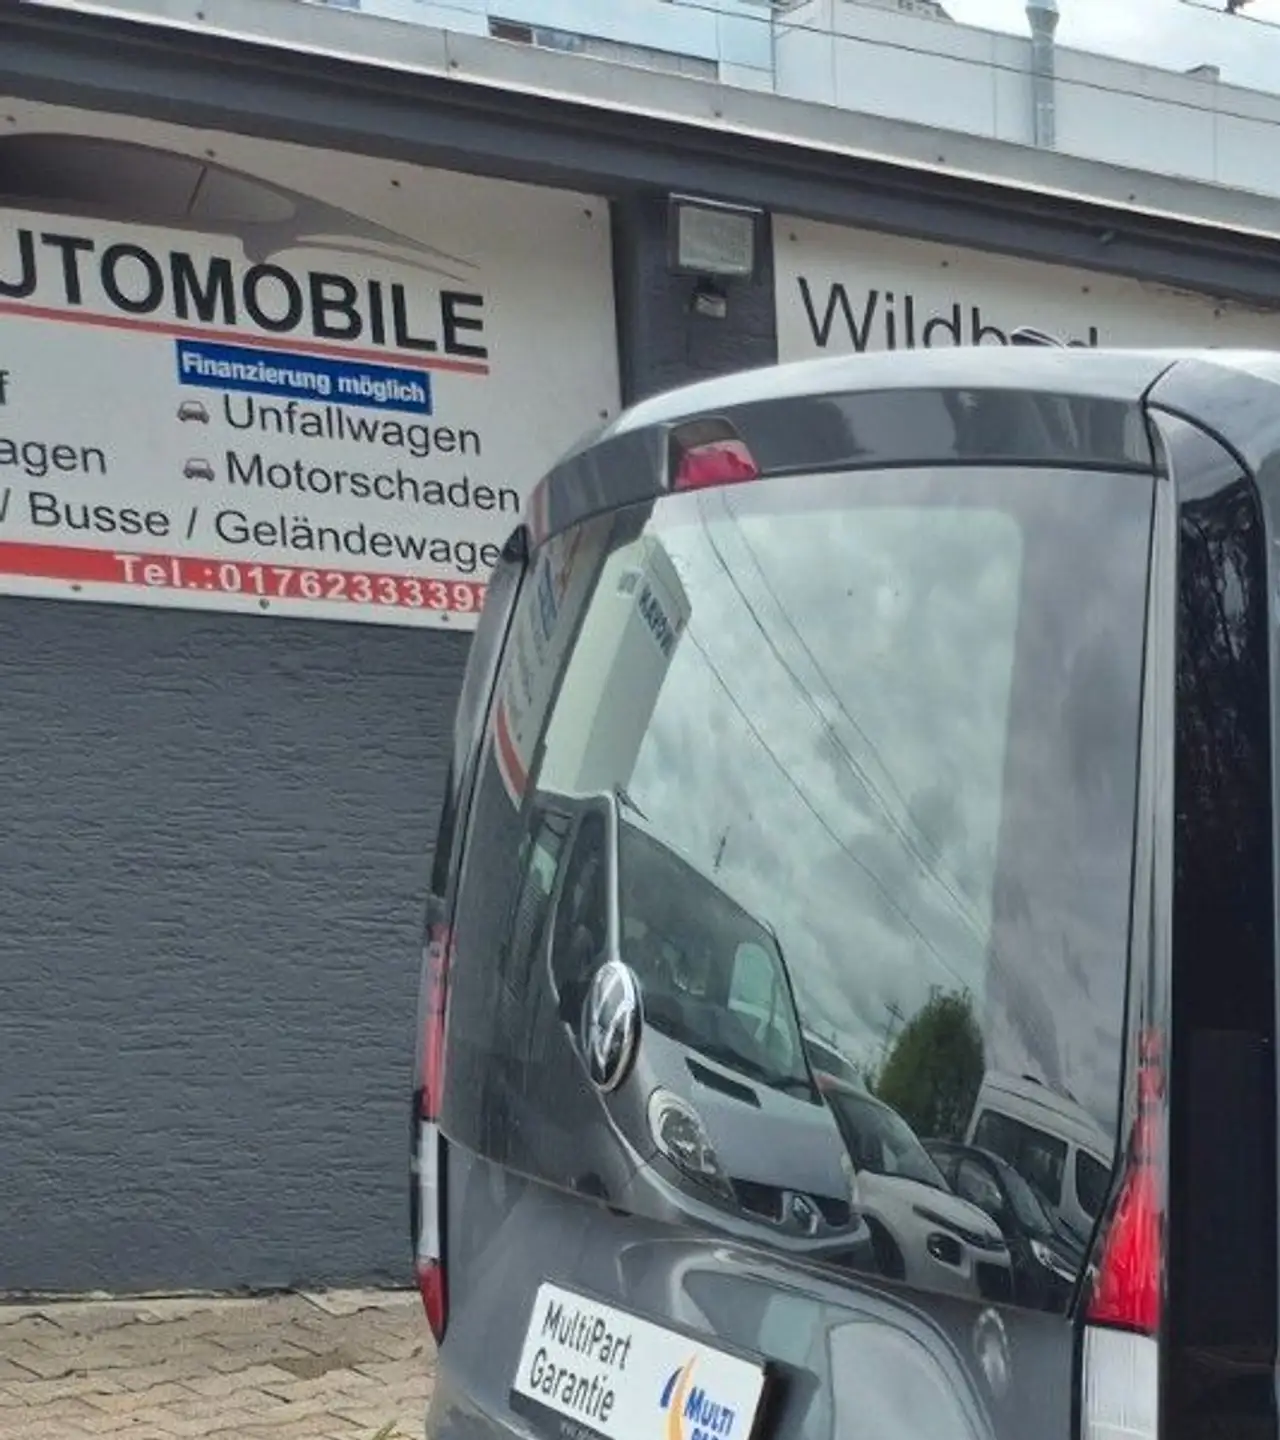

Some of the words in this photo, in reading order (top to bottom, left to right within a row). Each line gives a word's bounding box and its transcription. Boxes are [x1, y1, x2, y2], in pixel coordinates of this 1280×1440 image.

[797, 277, 1097, 351] Wildb
[181, 352, 332, 394] Finanzierung
[338, 374, 426, 403] möglich
[224, 394, 480, 457] Unfallwagen
[226, 451, 520, 512] Motorschaden
[29, 491, 170, 537] Busse
[186, 507, 197, 540] /
[541, 1301, 632, 1370] MultiPart
[529, 1348, 615, 1423] Garantie
[683, 1387, 735, 1436] MULTI
